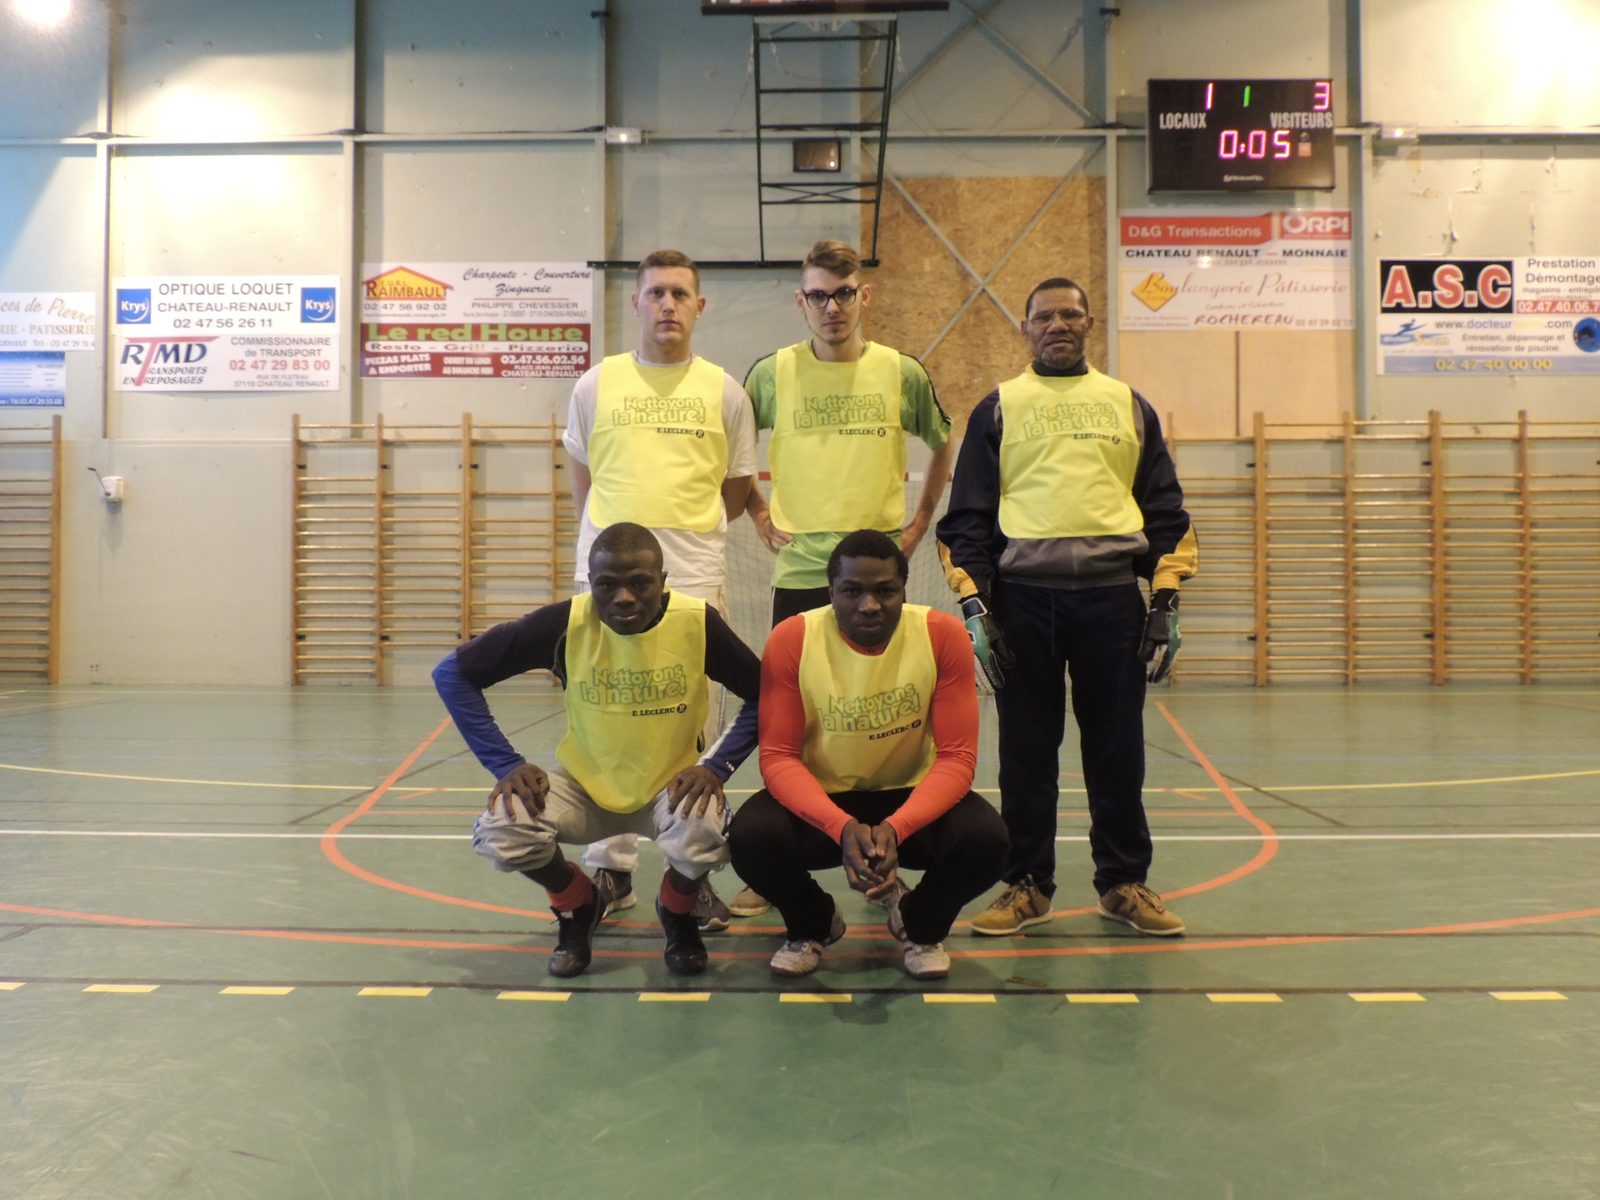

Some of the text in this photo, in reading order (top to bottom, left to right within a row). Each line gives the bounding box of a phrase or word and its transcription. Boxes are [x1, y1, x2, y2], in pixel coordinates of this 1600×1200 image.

[1314, 82, 1330, 110] 3
[1159, 113, 1207, 129] LOCAUX
[1270, 112, 1333, 129] VISITEURS
[1283, 214, 1349, 233] ORPI
[1129, 225, 1262, 238] D&G Transactions
[1126, 248, 1348, 258] CHATEAU RENAULT MONNAIE
[463, 267, 591, 281] Charpente Couverture
[158, 283, 293, 295] OPTIQUE LOQUET
[366, 280, 447, 297] RAIMBAULT
[1382, 264, 1512, 308] A.S.C
[25, 296, 42, 312] de
[47, 296, 95, 324] Pierre
[121, 301, 146, 314] Krys
[157, 302, 292, 312] CHATEAU-RENAULT
[305, 299, 330, 313] Krys
[173, 318, 272, 328] 02 47 56 26 11
[1194, 313, 1294, 325] ROCHEREAU
[29, 323, 95, 335] PATISSERIE
[368, 324, 583, 342] Le red House
[231, 337, 331, 346] COMMISSIONNAIRE
[371, 343, 422, 351] Resto
[508, 344, 583, 352] Pizzeria
[245, 349, 321, 357] de TRANSPORT
[400, 354, 430, 363] PLATS
[229, 360, 246, 371] 02
[250, 360, 267, 371] 47
[271, 360, 287, 371] 29
[313, 360, 330, 371] 00
[379, 363, 431, 374] EMPORTER
[624, 396, 704, 411] Nettoyons
[805, 394, 882, 413] Nettoyons
[1033, 402, 1113, 420] Nettoyons
[592, 664, 684, 688] Nettoyons
[829, 683, 916, 716] Nettoyons
